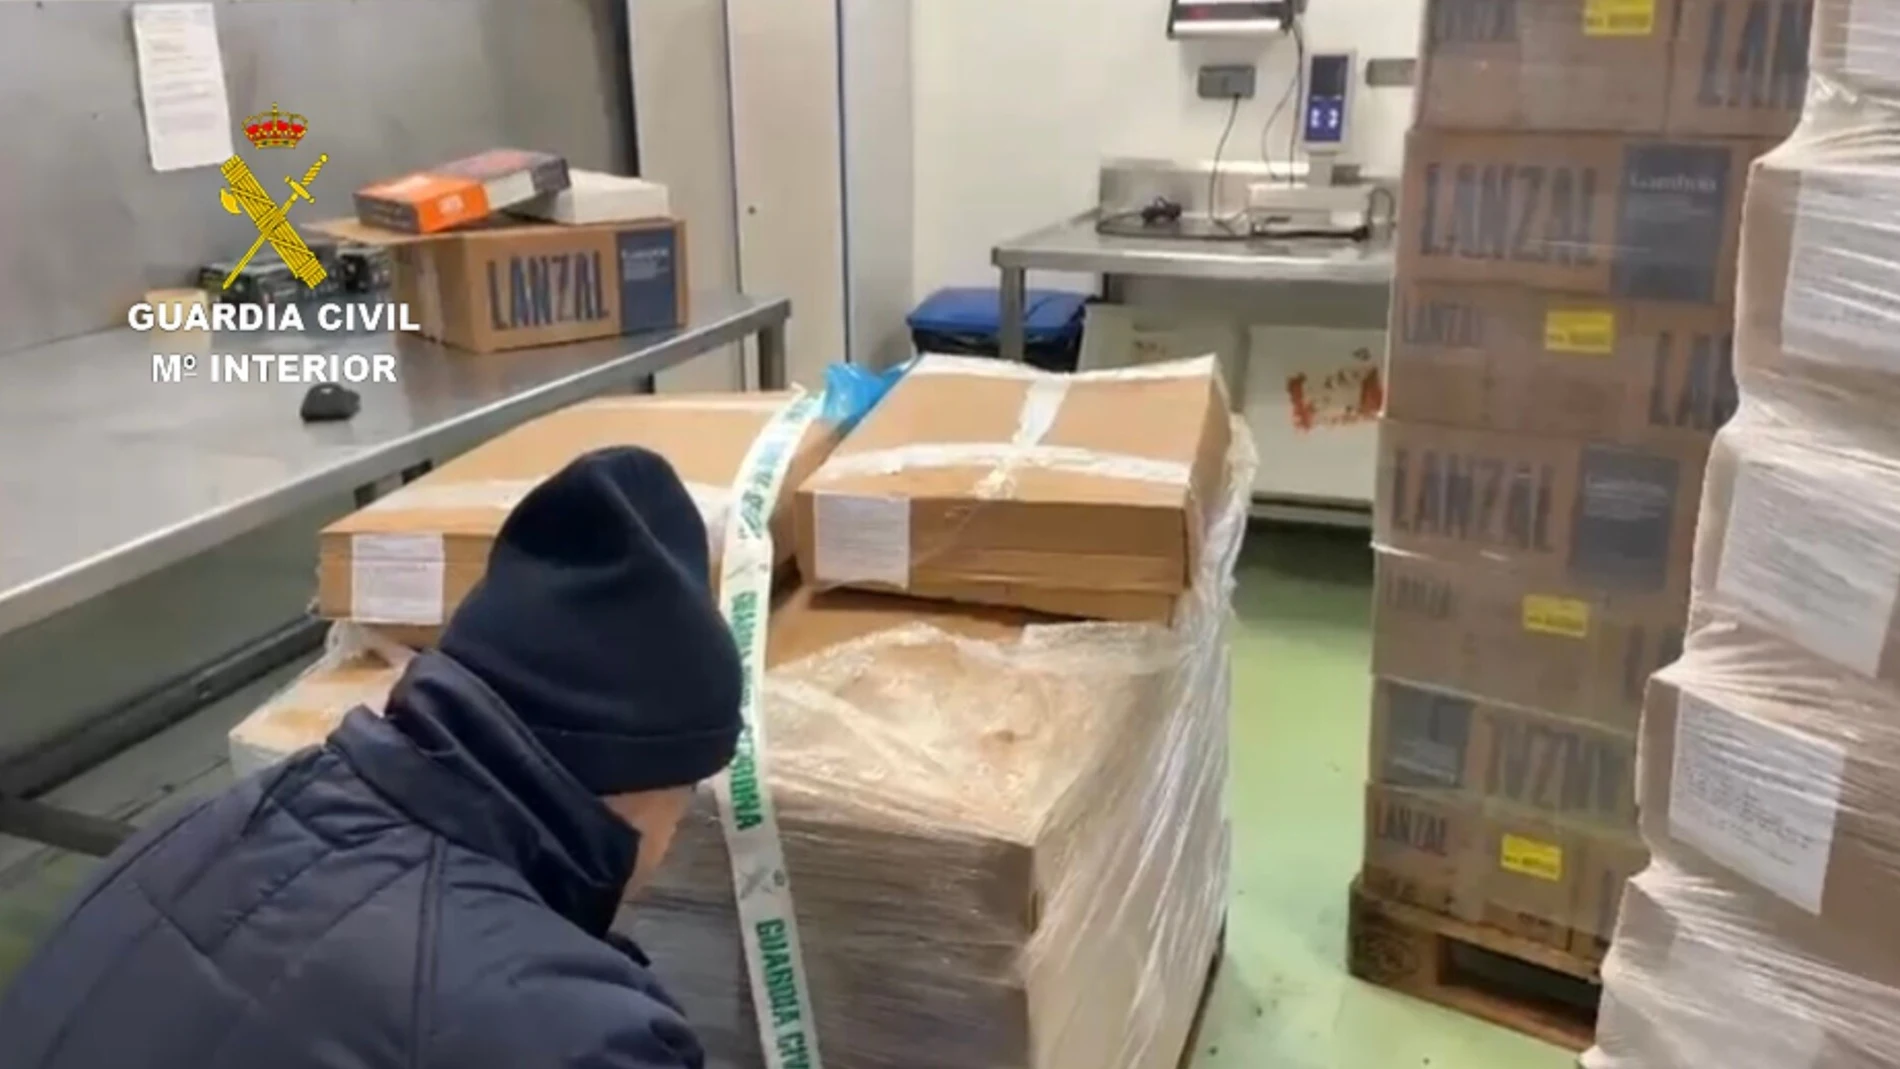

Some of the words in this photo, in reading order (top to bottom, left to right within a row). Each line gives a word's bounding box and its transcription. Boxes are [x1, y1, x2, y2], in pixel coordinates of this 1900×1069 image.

[1419, 161, 1600, 267] LANZAL
[487, 249, 610, 331] LANZAL
[1390, 446, 1555, 555] LANZAL
[1375, 800, 1447, 857] LANZAL
[756, 918, 805, 1029] GUARDIA
